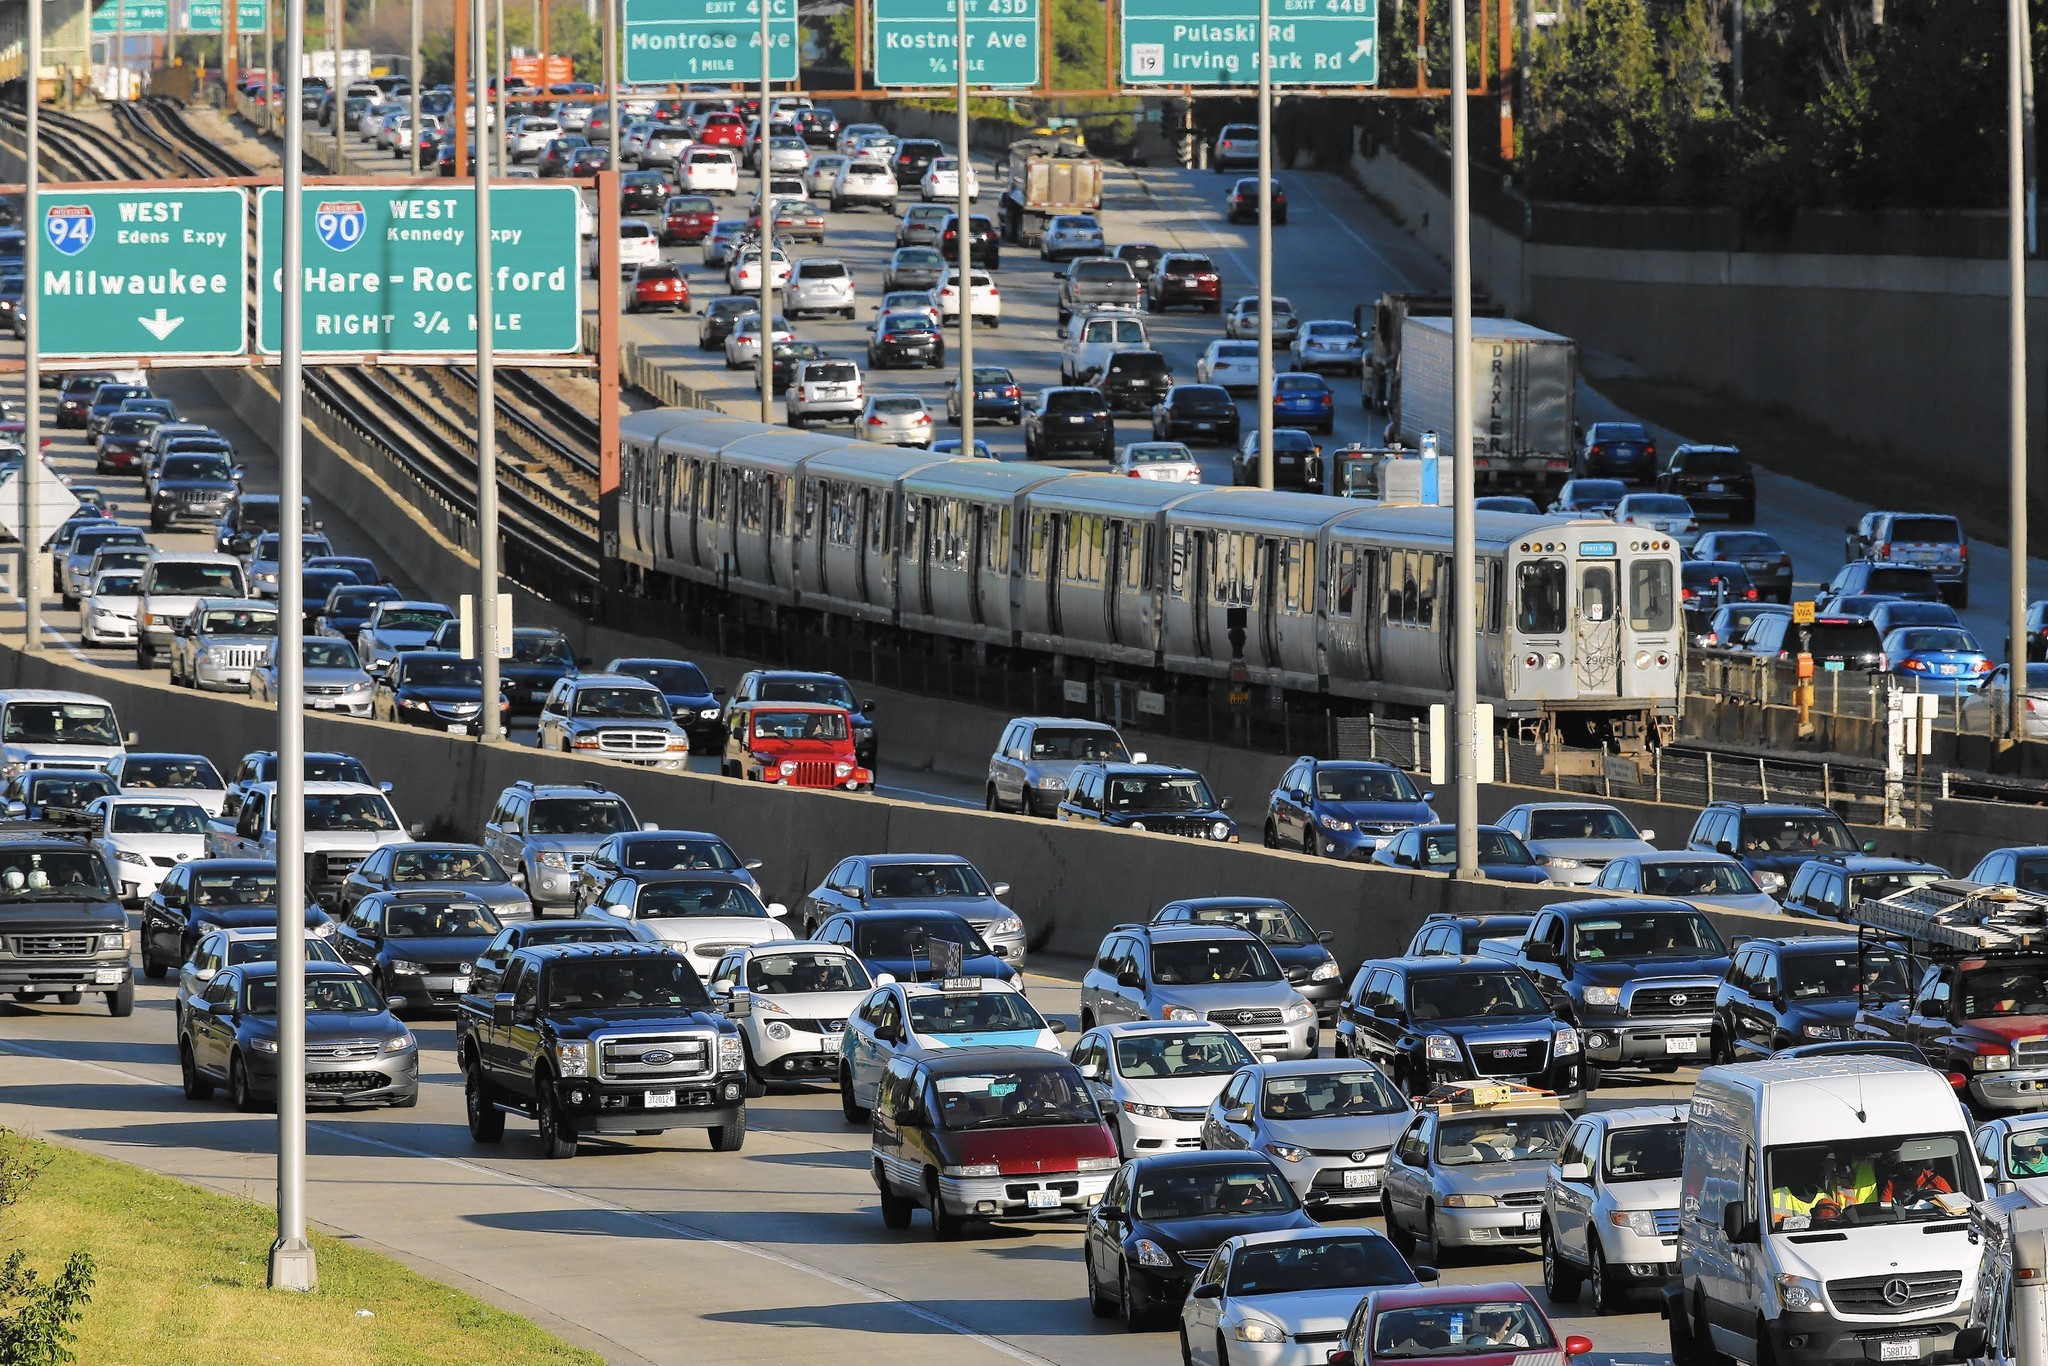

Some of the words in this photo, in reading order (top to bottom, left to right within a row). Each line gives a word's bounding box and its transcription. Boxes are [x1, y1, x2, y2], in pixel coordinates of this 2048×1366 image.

[705, 1, 736, 13] EXIT
[946, 0, 977, 12] EIT
[988, 0, 1028, 14] 43D
[1284, 0, 1315, 10] EXIT
[631, 32, 737, 50] Montrose
[749, 31, 791, 48] Ave
[986, 31, 1028, 48] Ave
[1173, 23, 1256, 42] Pulaski
[1269, 24, 1296, 42] Rd
[688, 57, 697, 74] 1
[702, 58, 734, 71] MILE
[952, 59, 985, 71] LE
[1140, 56, 1155, 70] 19
[1173, 51, 1239, 73] Irving
[1252, 51, 1302, 69] Park
[1314, 52, 1342, 70] Rd
[118, 202, 184, 222] WEST
[389, 199, 457, 219] WEST
[49, 218, 89, 245] 94
[319, 215, 360, 241] 90
[387, 228, 465, 246] Kennedy
[490, 229, 522, 245] xpy
[117, 230, 170, 244] Edens
[183, 229, 227, 248] Expy
[44, 268, 228, 295] Milwaukee
[273, 266, 380, 293] Hare
[412, 265, 566, 292] Rocford
[315, 314, 395, 335] RIGHT
[467, 313, 522, 331] MLE
[1490, 344, 1503, 452] DRAXLER
[1493, 1048, 1528, 1058] GMC
